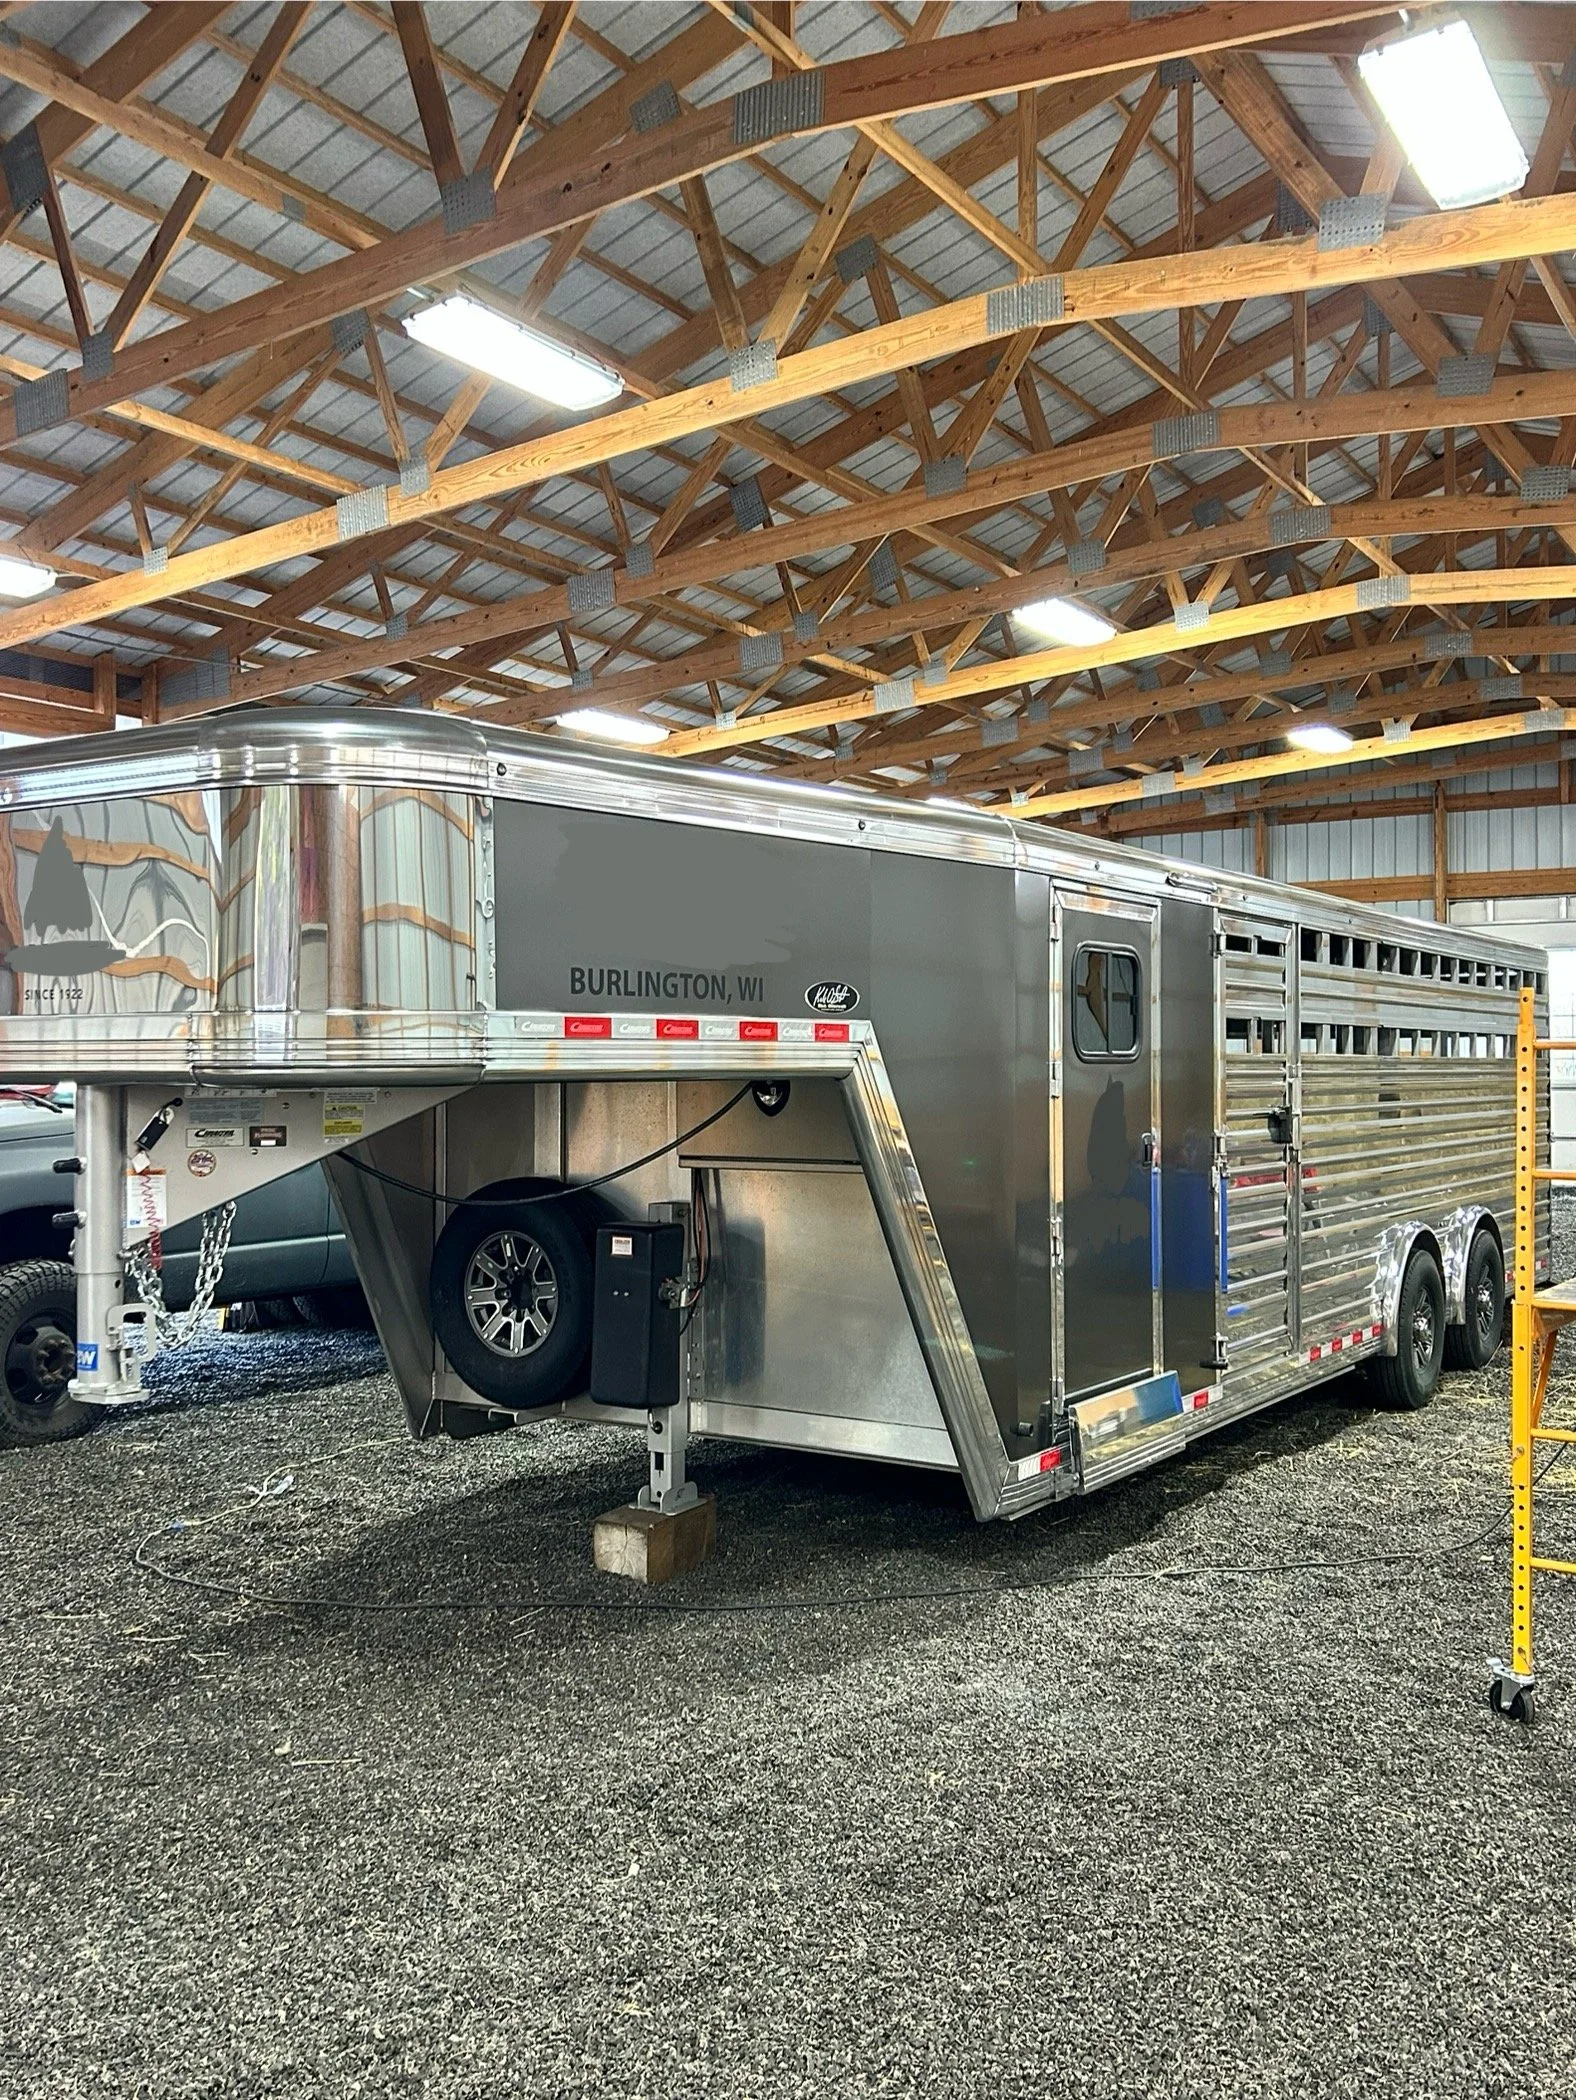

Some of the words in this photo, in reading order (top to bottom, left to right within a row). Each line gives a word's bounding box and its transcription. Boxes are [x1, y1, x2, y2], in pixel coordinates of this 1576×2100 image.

[25, 989, 55, 1000] SINCE
[60, 988, 83, 1000] 1922
[570, 967, 732, 1004] BURLINGTON,
[737, 976, 764, 1002] WI
